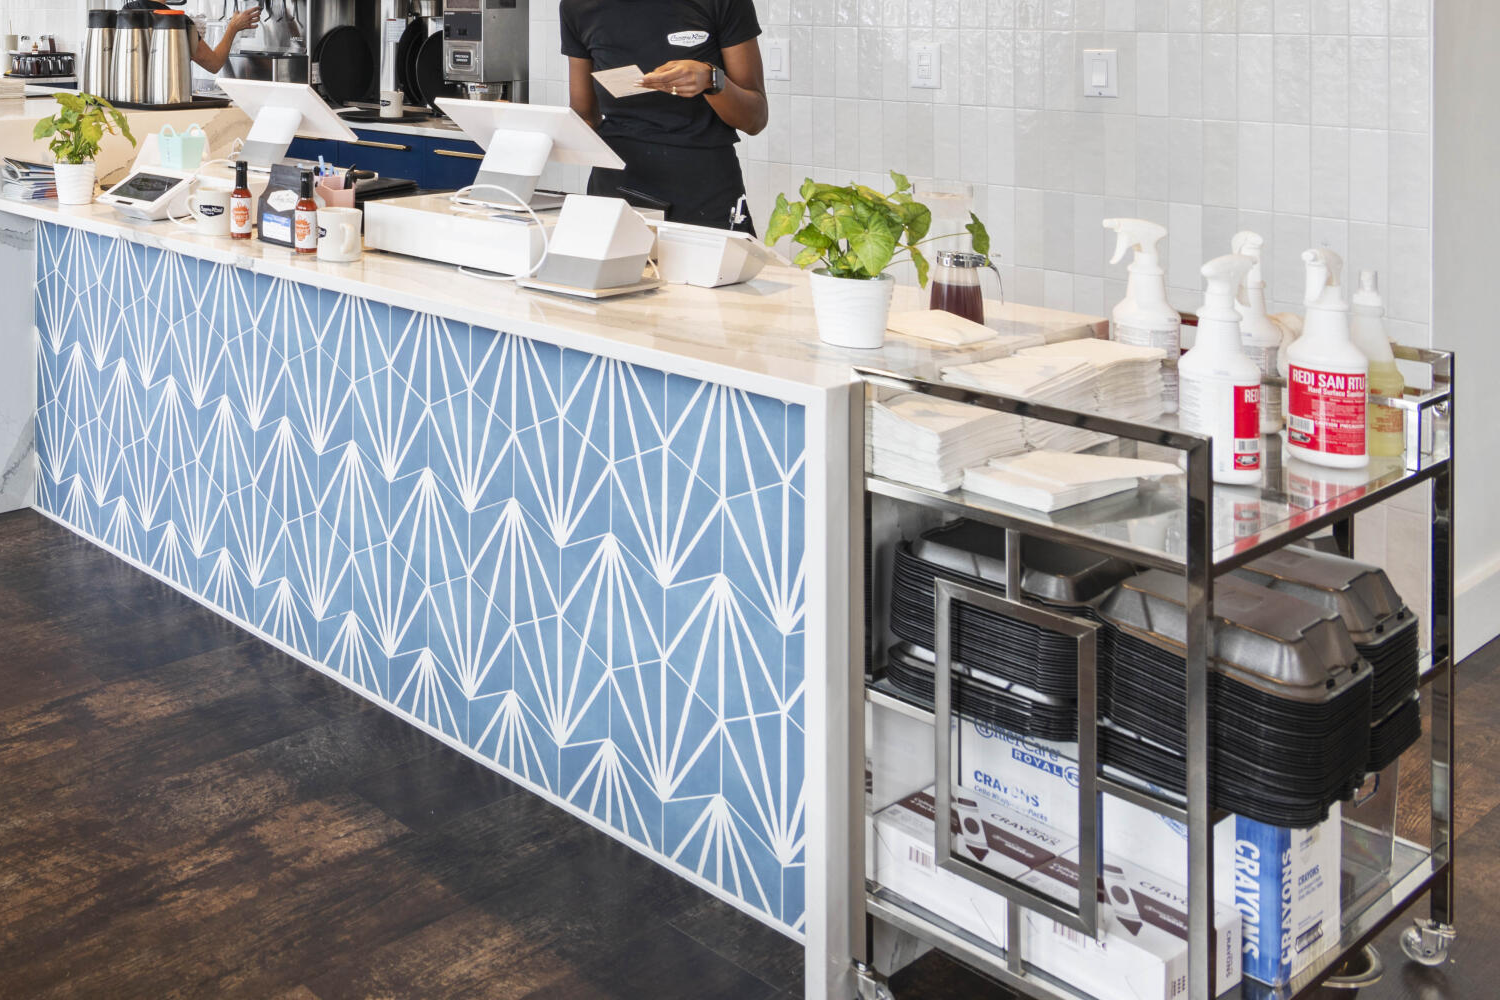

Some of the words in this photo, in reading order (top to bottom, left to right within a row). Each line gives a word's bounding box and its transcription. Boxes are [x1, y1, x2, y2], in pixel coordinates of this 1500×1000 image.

[1292, 368, 1315, 386] REDI
[1318, 373, 1345, 390] SAN
[1347, 376, 1365, 390] RTU
[1013, 749, 1062, 776] ROYAL
[990, 813, 1057, 846] CRAYONS
[1298, 865, 1320, 886] CRAYONS
[1139, 880, 1188, 906] CRAY
[1236, 839, 1260, 961] CRAYONS
[1281, 848, 1292, 966] CRAYONS
